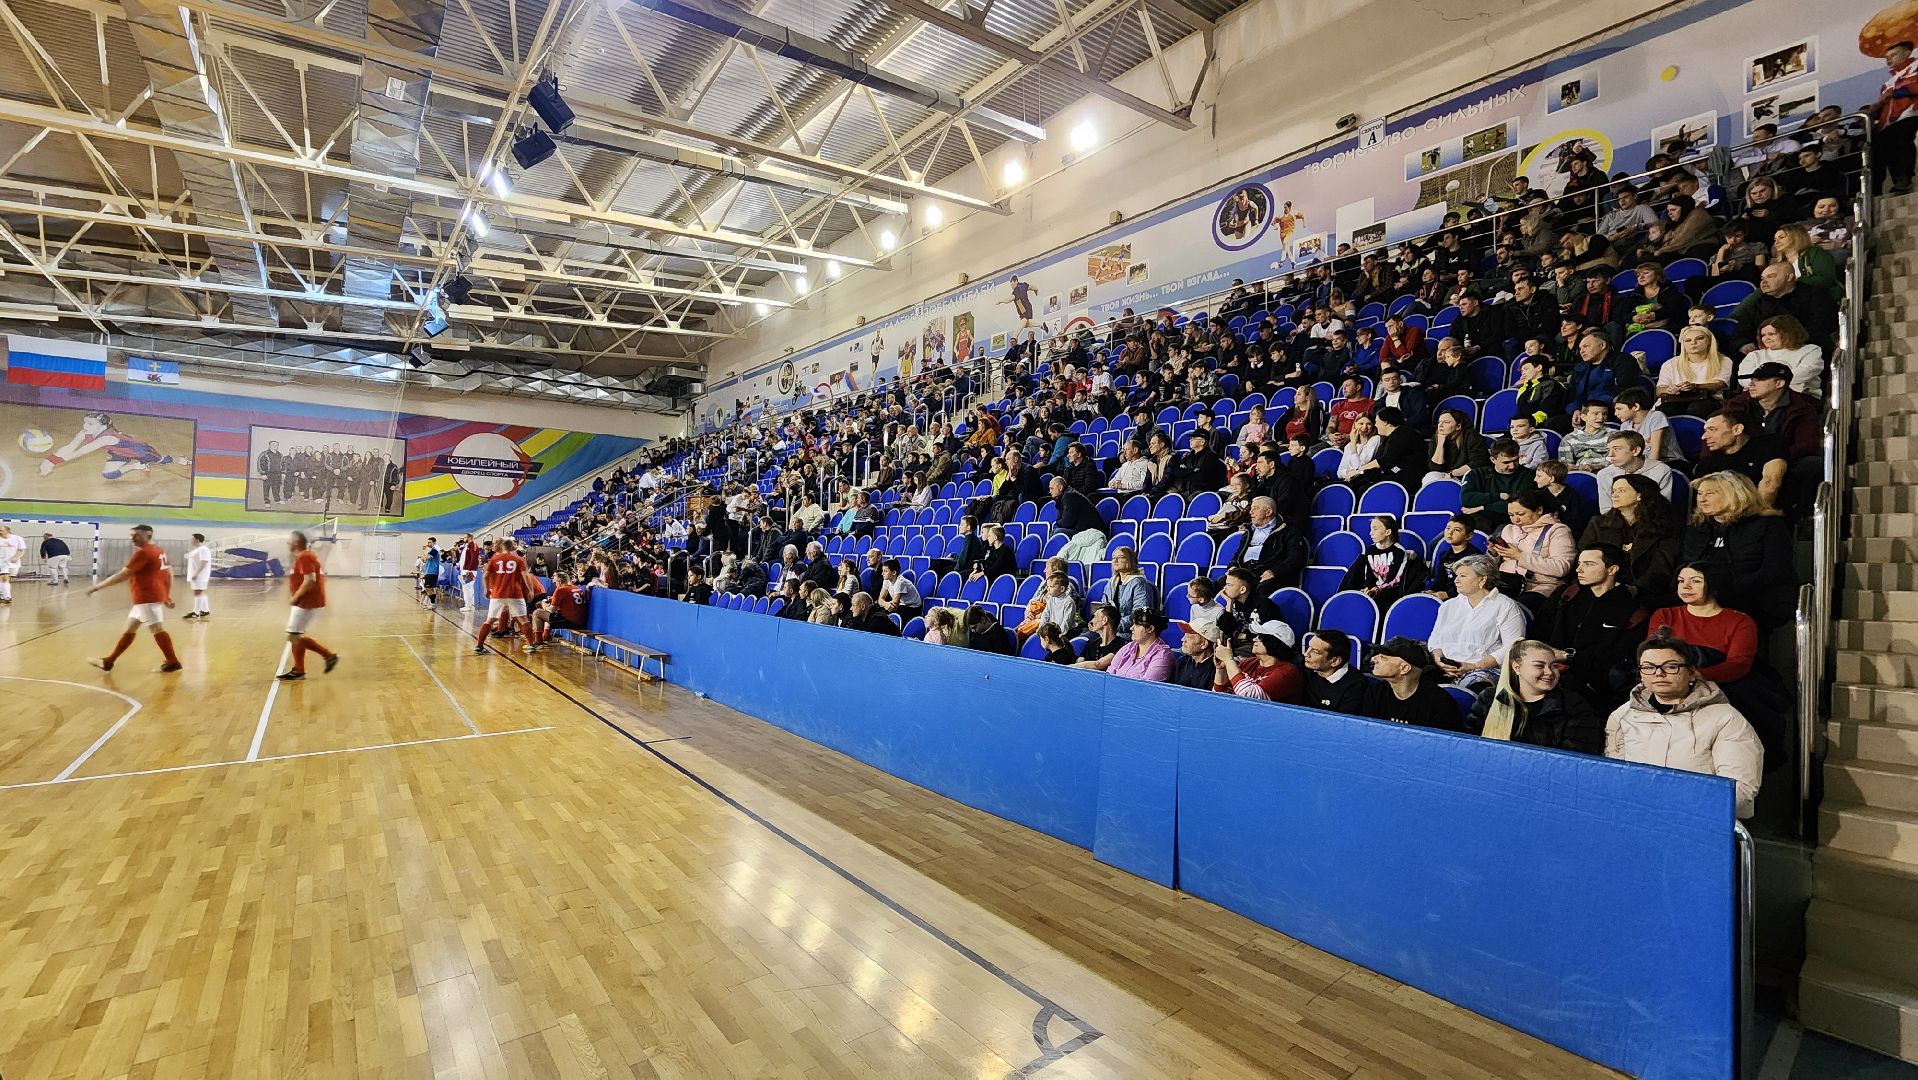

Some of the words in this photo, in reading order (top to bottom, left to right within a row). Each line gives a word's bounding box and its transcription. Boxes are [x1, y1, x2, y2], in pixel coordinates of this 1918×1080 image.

[1424, 84, 1527, 131] СИЛЬНЫХ
[1100, 301, 1120, 312] ТВОЯ
[447, 456, 519, 469] ЮБИЛЕЙНЫЙ
[496, 560, 517, 574] 19
